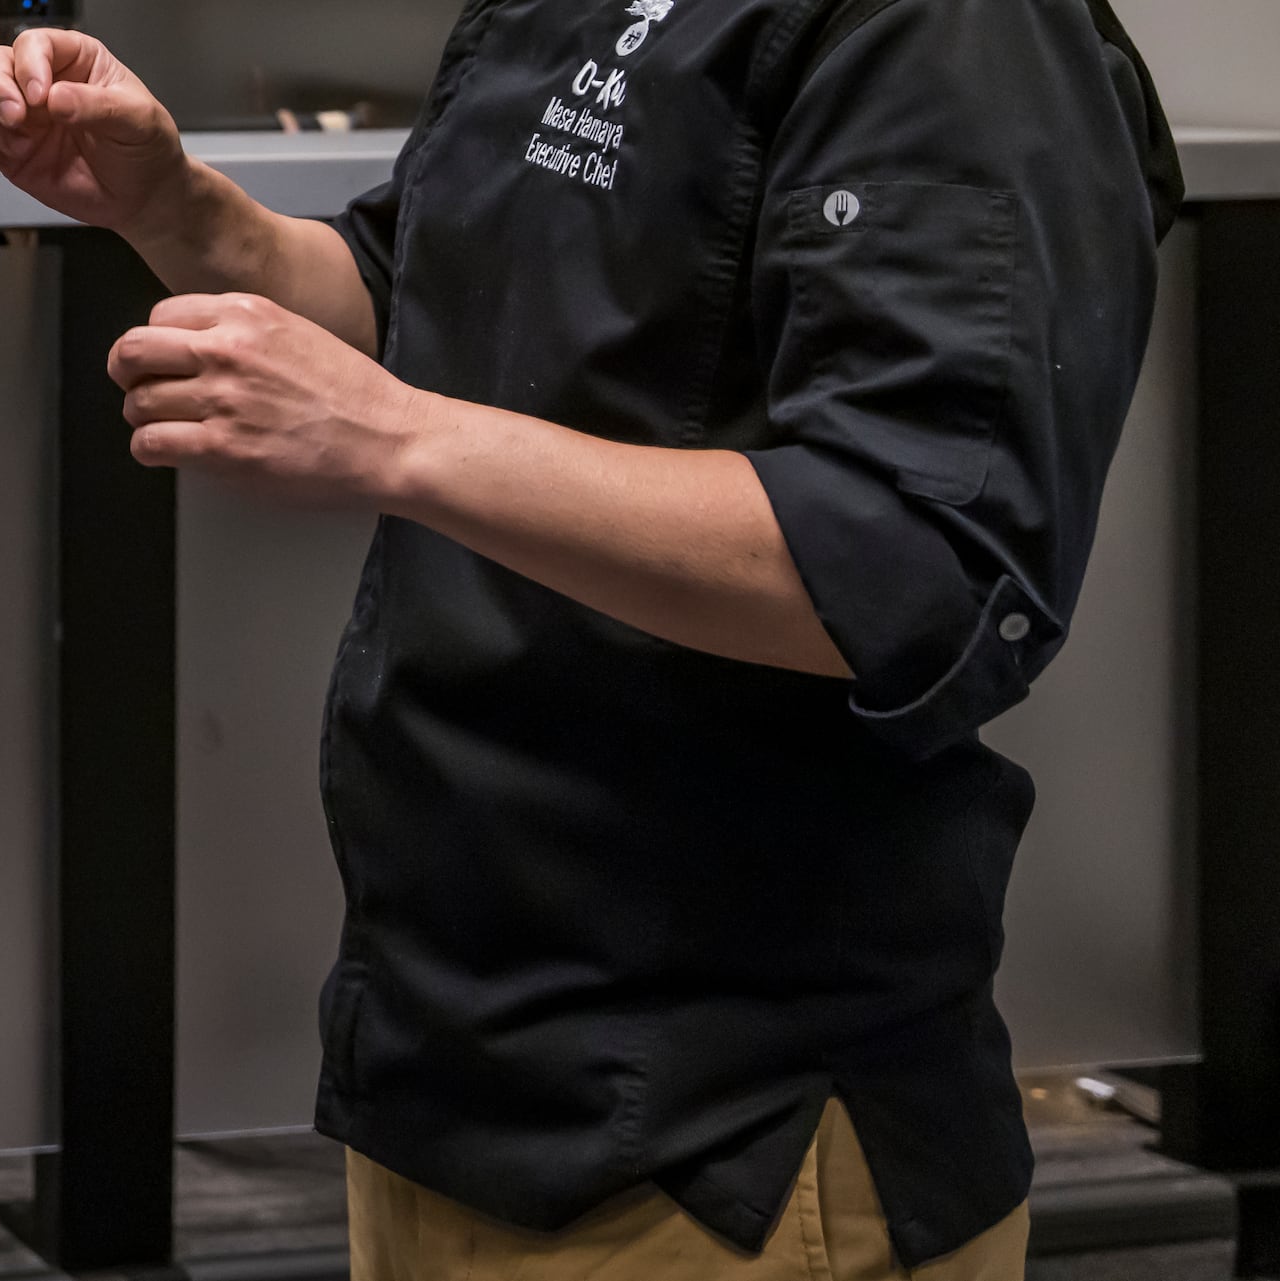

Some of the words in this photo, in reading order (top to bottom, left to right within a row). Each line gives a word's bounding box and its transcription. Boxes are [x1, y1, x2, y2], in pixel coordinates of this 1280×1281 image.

[541, 96, 577, 133] Masa
[573, 107, 624, 154] Hamaya
[525, 133, 582, 179] Executive
[583, 152, 618, 191] Chef
